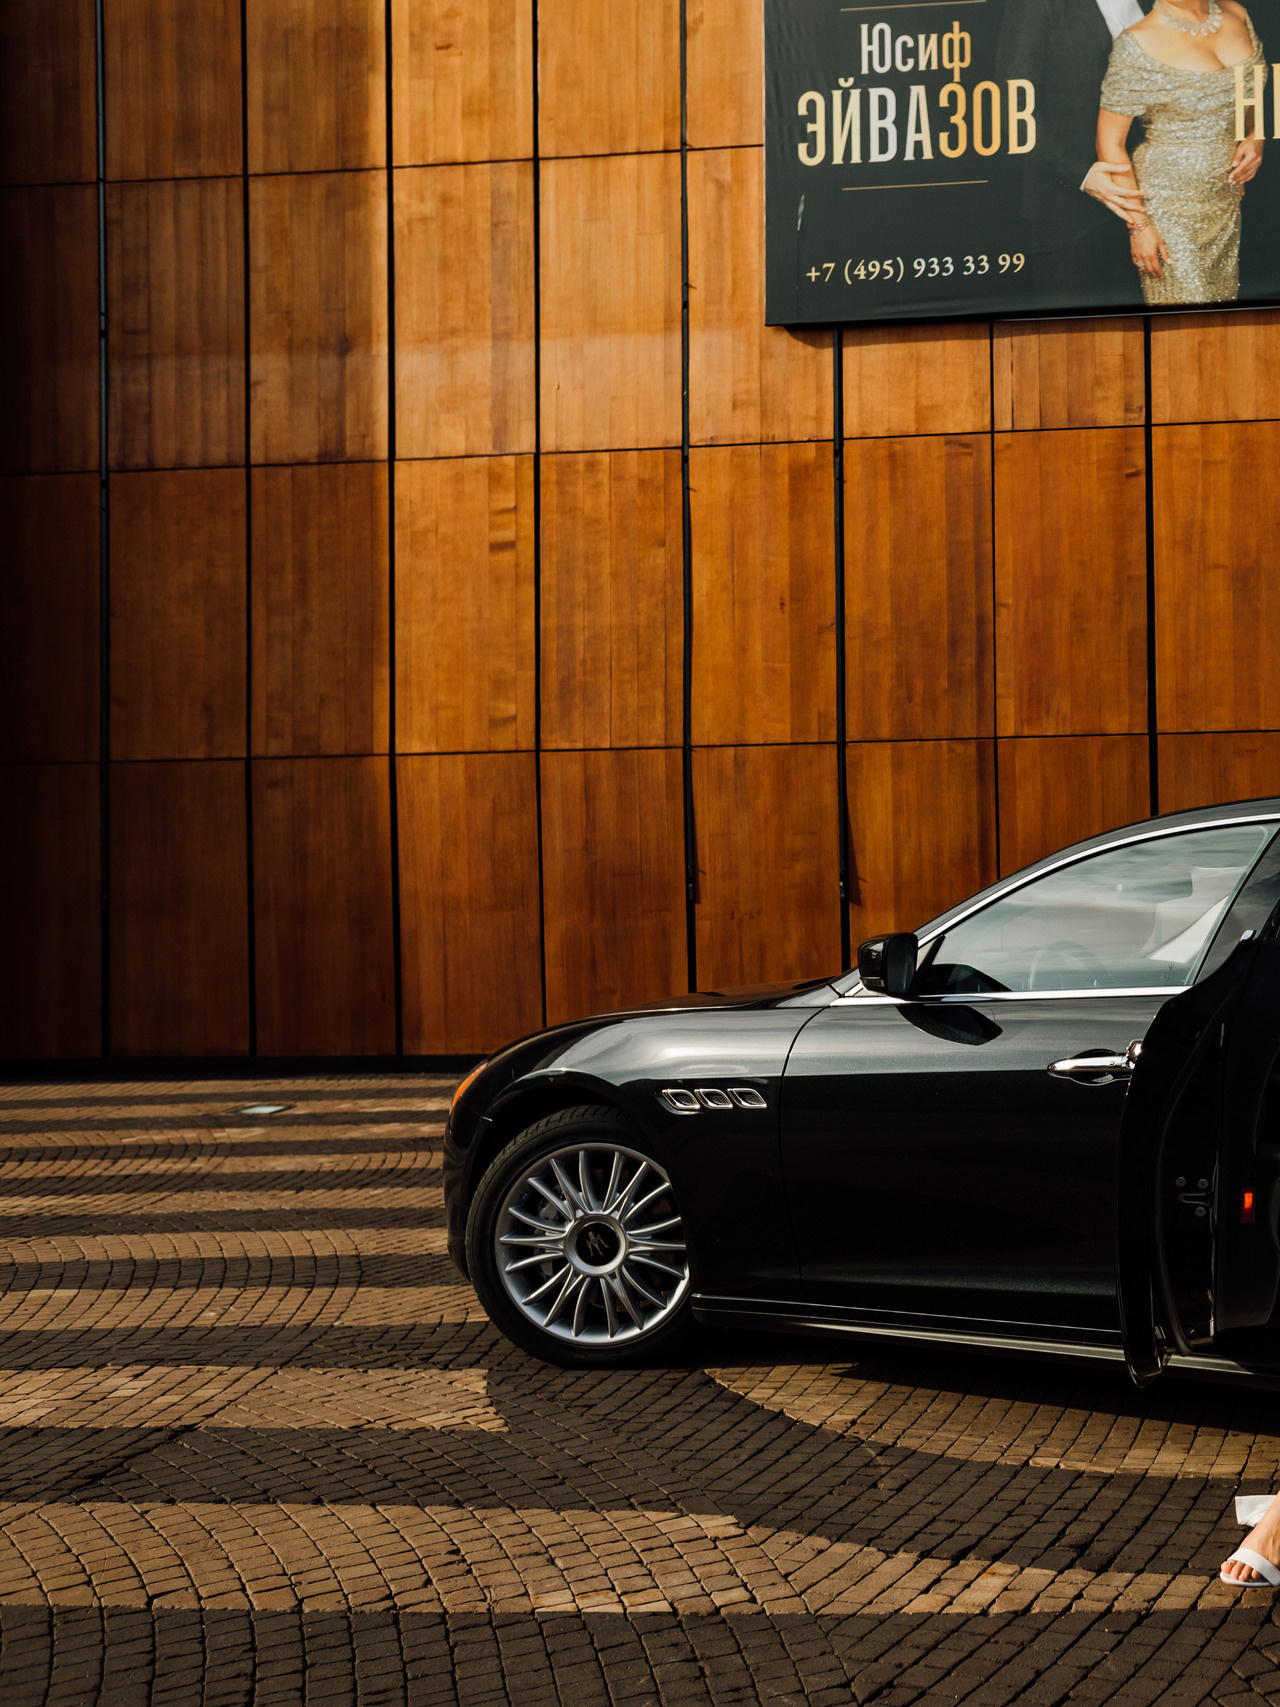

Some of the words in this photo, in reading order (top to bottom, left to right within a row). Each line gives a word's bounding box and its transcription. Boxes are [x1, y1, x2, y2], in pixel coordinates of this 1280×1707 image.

[860, 21, 972, 83] Юсиф
[797, 77, 1037, 166] ЭЙВАЗОВ
[806, 262, 836, 282] +7
[844, 257, 905, 285] (495)
[913, 256, 955, 278] 933
[963, 255, 990, 276] 33
[998, 252, 1026, 274] 99
